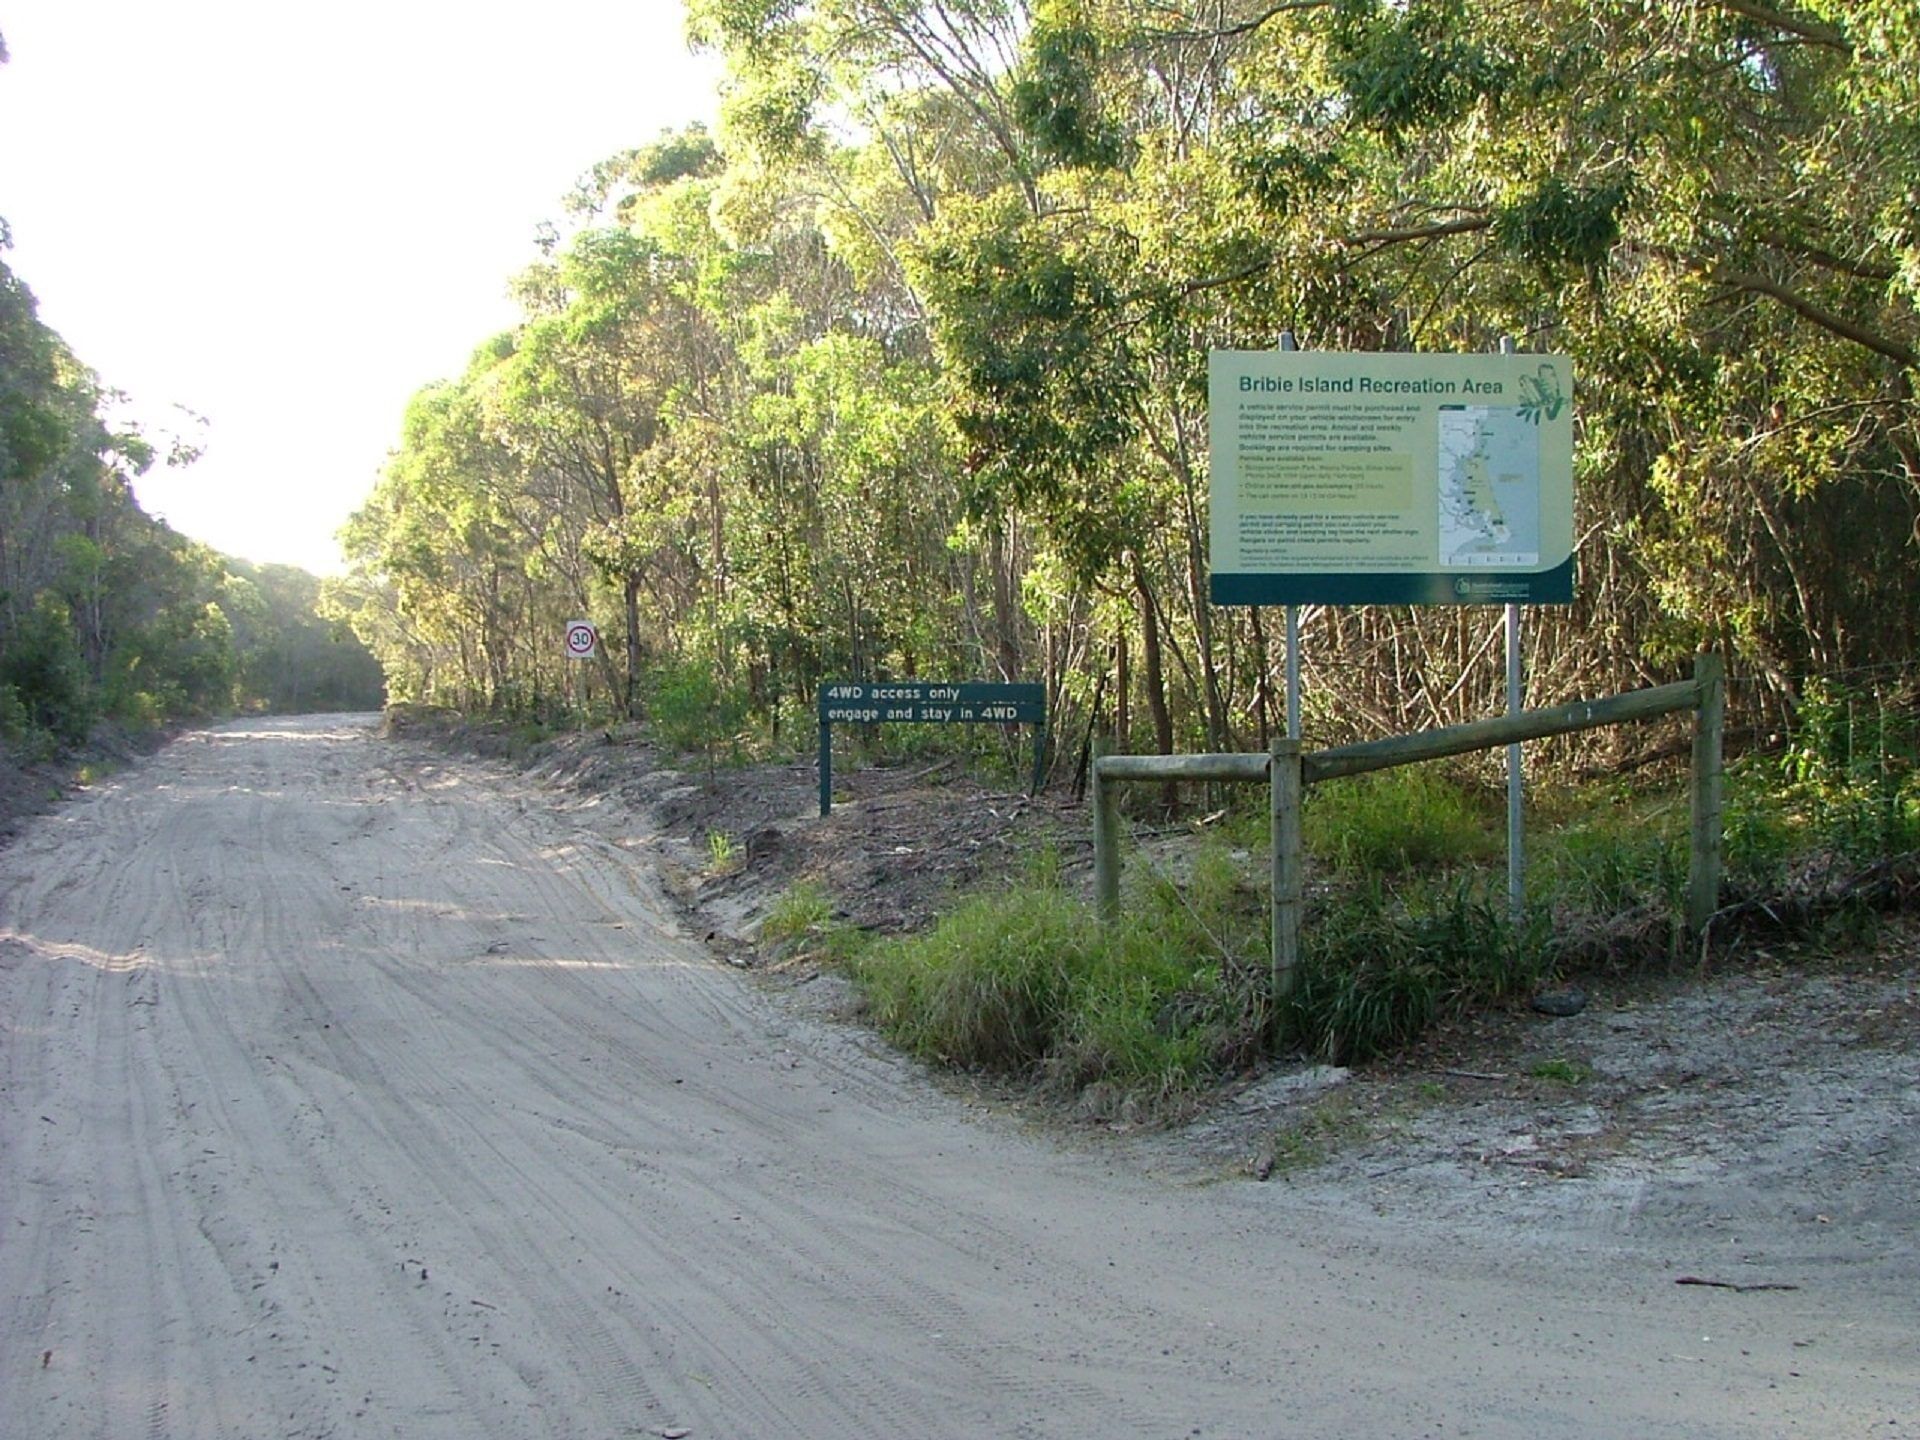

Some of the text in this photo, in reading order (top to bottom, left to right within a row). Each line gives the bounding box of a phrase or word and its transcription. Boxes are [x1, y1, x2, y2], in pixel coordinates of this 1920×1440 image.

[1240, 376, 1503, 394] Bribie Island Recreation Area
[1365, 405, 1404, 413] purchased
[1239, 414, 1275, 422] displayed
[1290, 414, 1306, 422] your
[1298, 434, 1326, 442] permits
[1239, 444, 1276, 453] Bookings
[1278, 444, 1289, 452] are
[1292, 444, 1324, 453] required
[1339, 445, 1371, 453] camping
[573, 633, 588, 645] 30
[828, 687, 960, 702] 4WD access only
[828, 708, 1017, 722] engage and stay in 4WD
